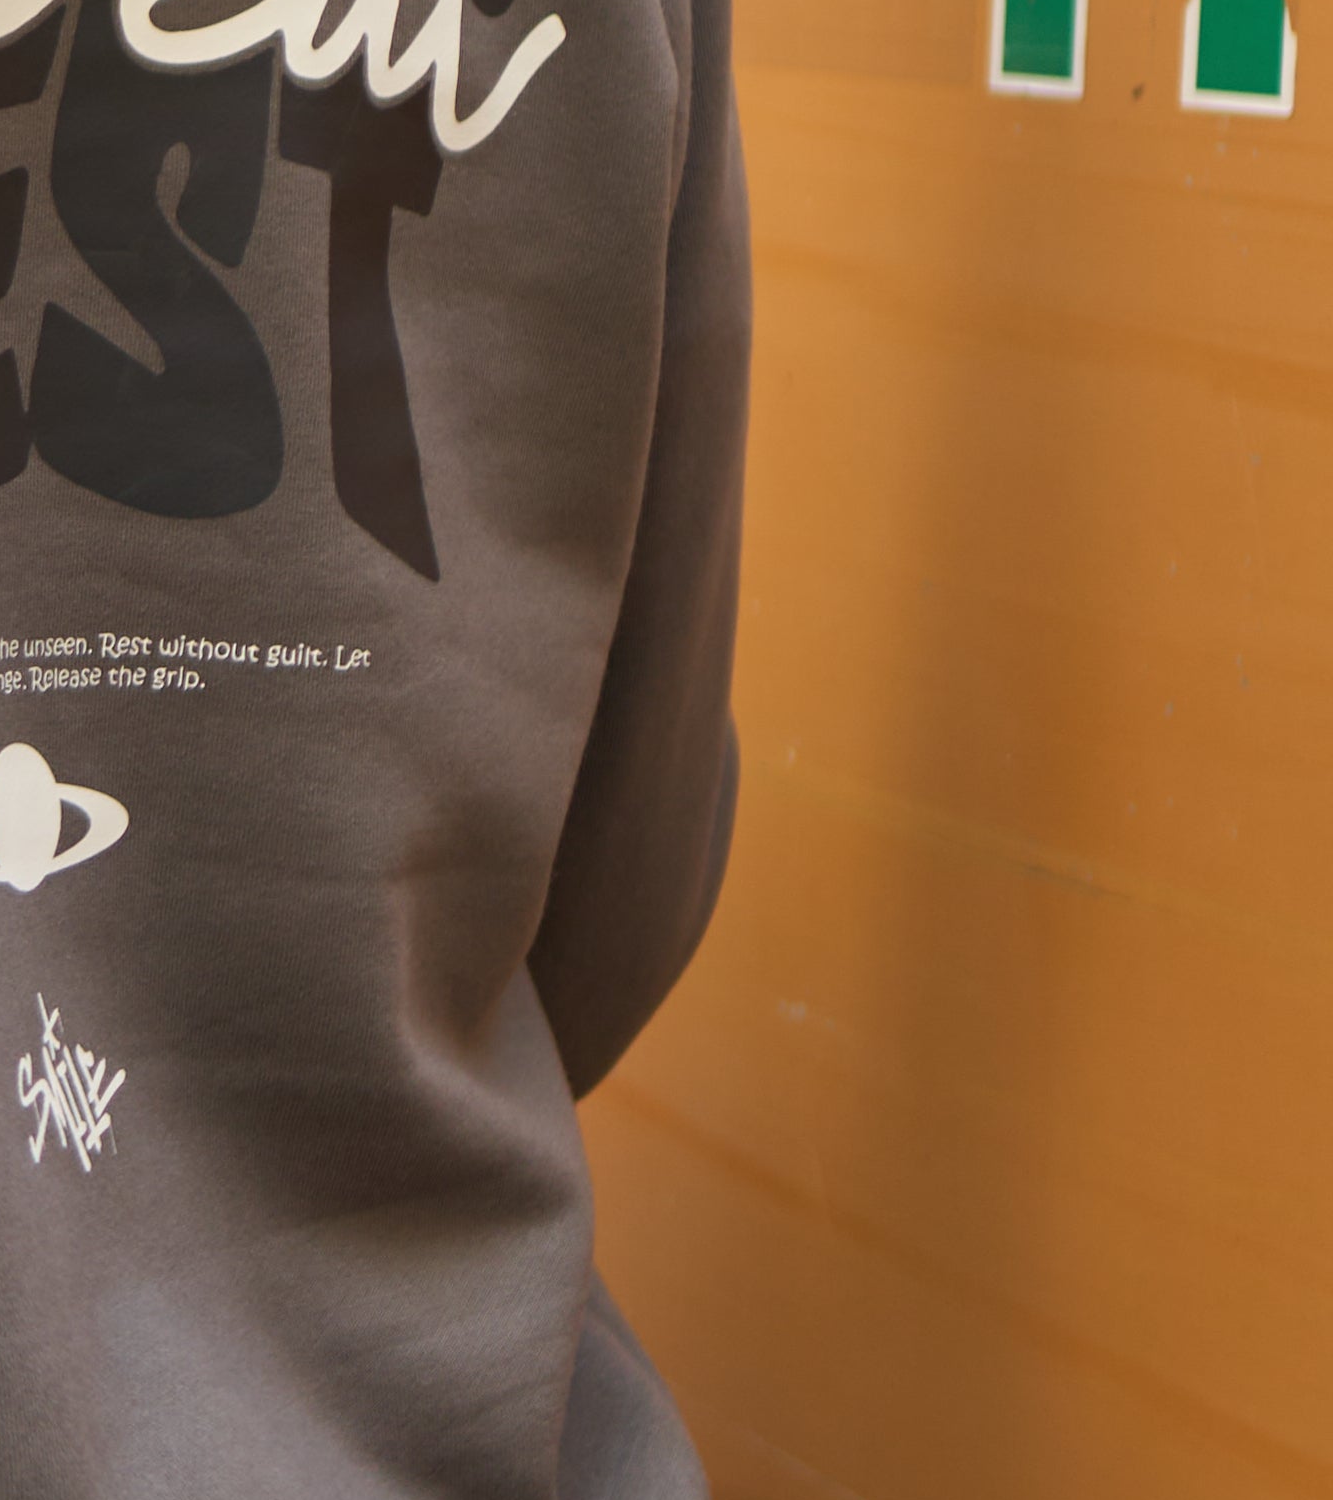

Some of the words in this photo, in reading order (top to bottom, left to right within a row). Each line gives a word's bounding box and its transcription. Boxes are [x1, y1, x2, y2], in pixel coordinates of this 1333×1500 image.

[23, 635, 93, 657] unseen.
[98, 631, 152, 660] Rest
[158, 634, 261, 663] without
[264, 642, 328, 669] guilt.
[333, 644, 372, 671] Let
[28, 665, 102, 693] Release
[108, 664, 147, 688] the
[152, 665, 207, 692] grip.
